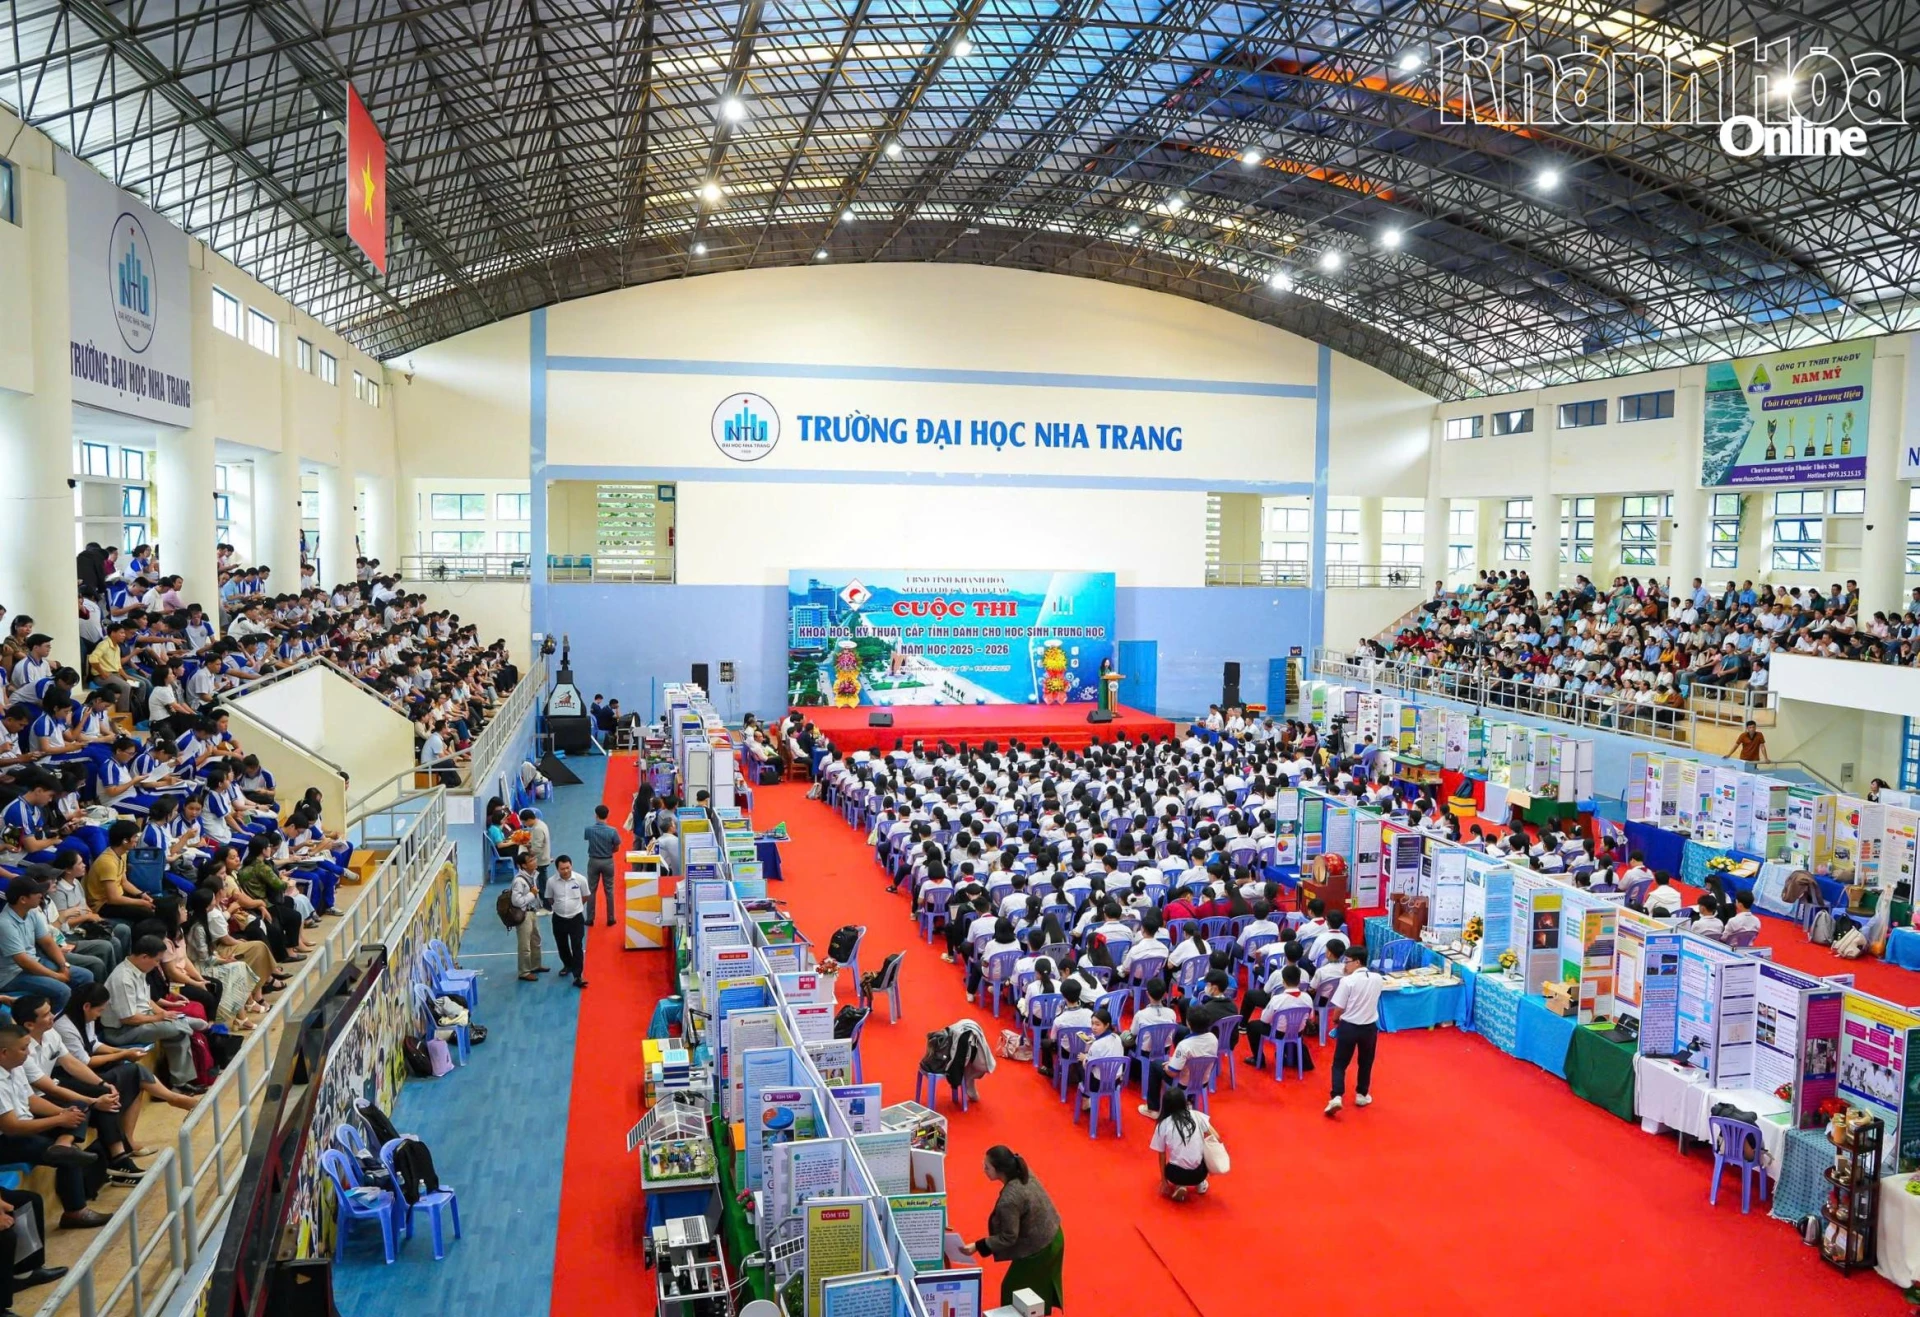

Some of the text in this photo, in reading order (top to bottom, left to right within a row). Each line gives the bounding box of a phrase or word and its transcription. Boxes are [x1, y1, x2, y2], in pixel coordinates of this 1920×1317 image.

[122, 278, 147, 315] NTU
[70, 339, 191, 408] TRƯỜNG ĐẠI HỌC NHA TRANG
[1775, 362, 1795, 372] CÔNG
[1797, 361, 1807, 369] TY
[1809, 357, 1830, 368] TNHH
[1792, 366, 1842, 385] NAM MỸ
[728, 426, 764, 441] NTU
[797, 409, 1183, 452] TRƯỜNG ĐẠI HỌC NHA TRANG
[892, 597, 1017, 621] CUỘC THI
[799, 626, 826, 637] KHOA
[928, 622, 949, 637] TỈNH
[953, 624, 979, 637] DÀNH
[982, 627, 1001, 637] CHO
[1005, 627, 1024, 639] HỌC
[1027, 627, 1049, 637] SINH
[1053, 627, 1082, 637] TRUNG
[1085, 627, 1104, 639] HỌC
[927, 645, 946, 656] HỌC
[950, 644, 973, 655] 2025
[985, 645, 1009, 655] 2026
[838, 1210, 850, 1218] TẮT
